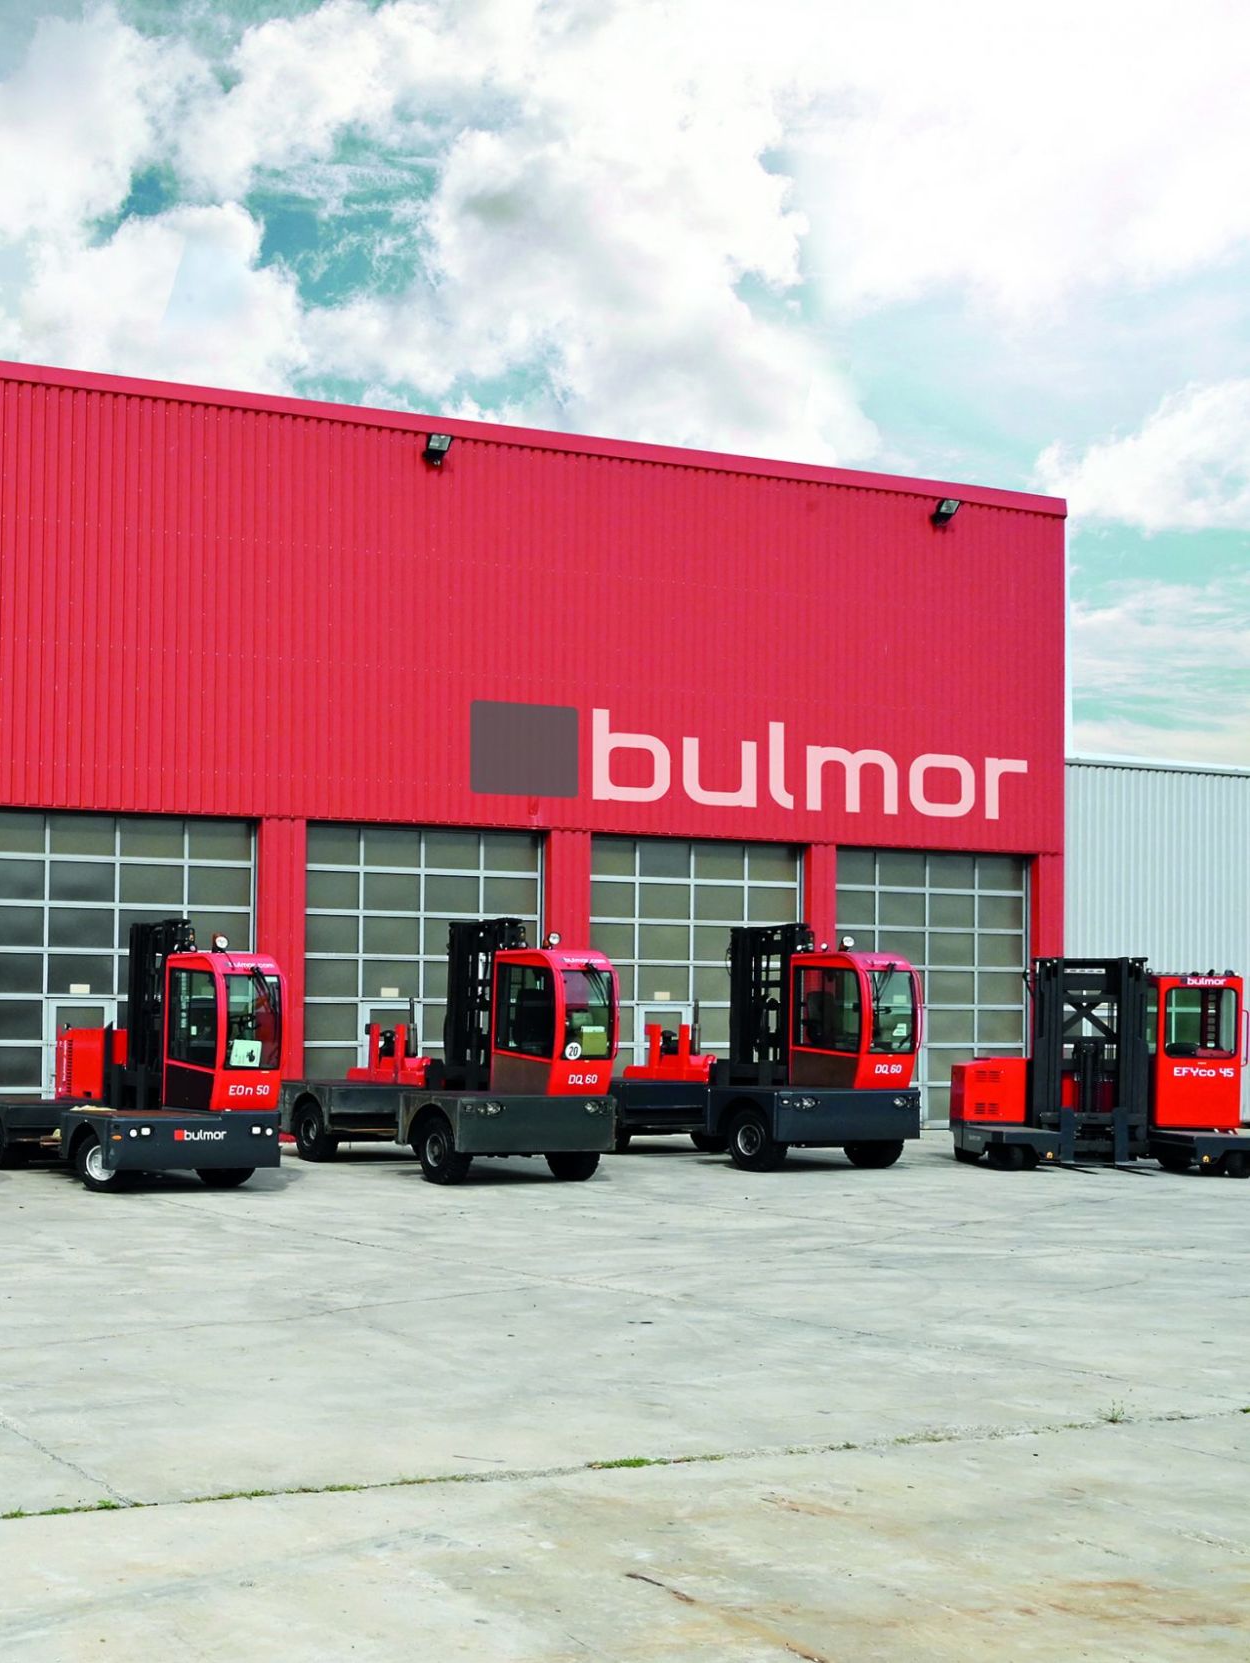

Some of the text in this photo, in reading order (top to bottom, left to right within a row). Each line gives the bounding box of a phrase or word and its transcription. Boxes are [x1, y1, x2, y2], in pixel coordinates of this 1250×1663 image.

[592, 708, 1028, 820] bulmor
[1186, 976, 1227, 986] bulmor
[568, 1046, 579, 1057] 20
[874, 1064, 890, 1075] DQ
[1173, 1066, 1235, 1078] EFYco 45
[567, 1074, 598, 1085] DQ 60
[255, 1084, 270, 1096] 50
[183, 1129, 228, 1141] bulmor
